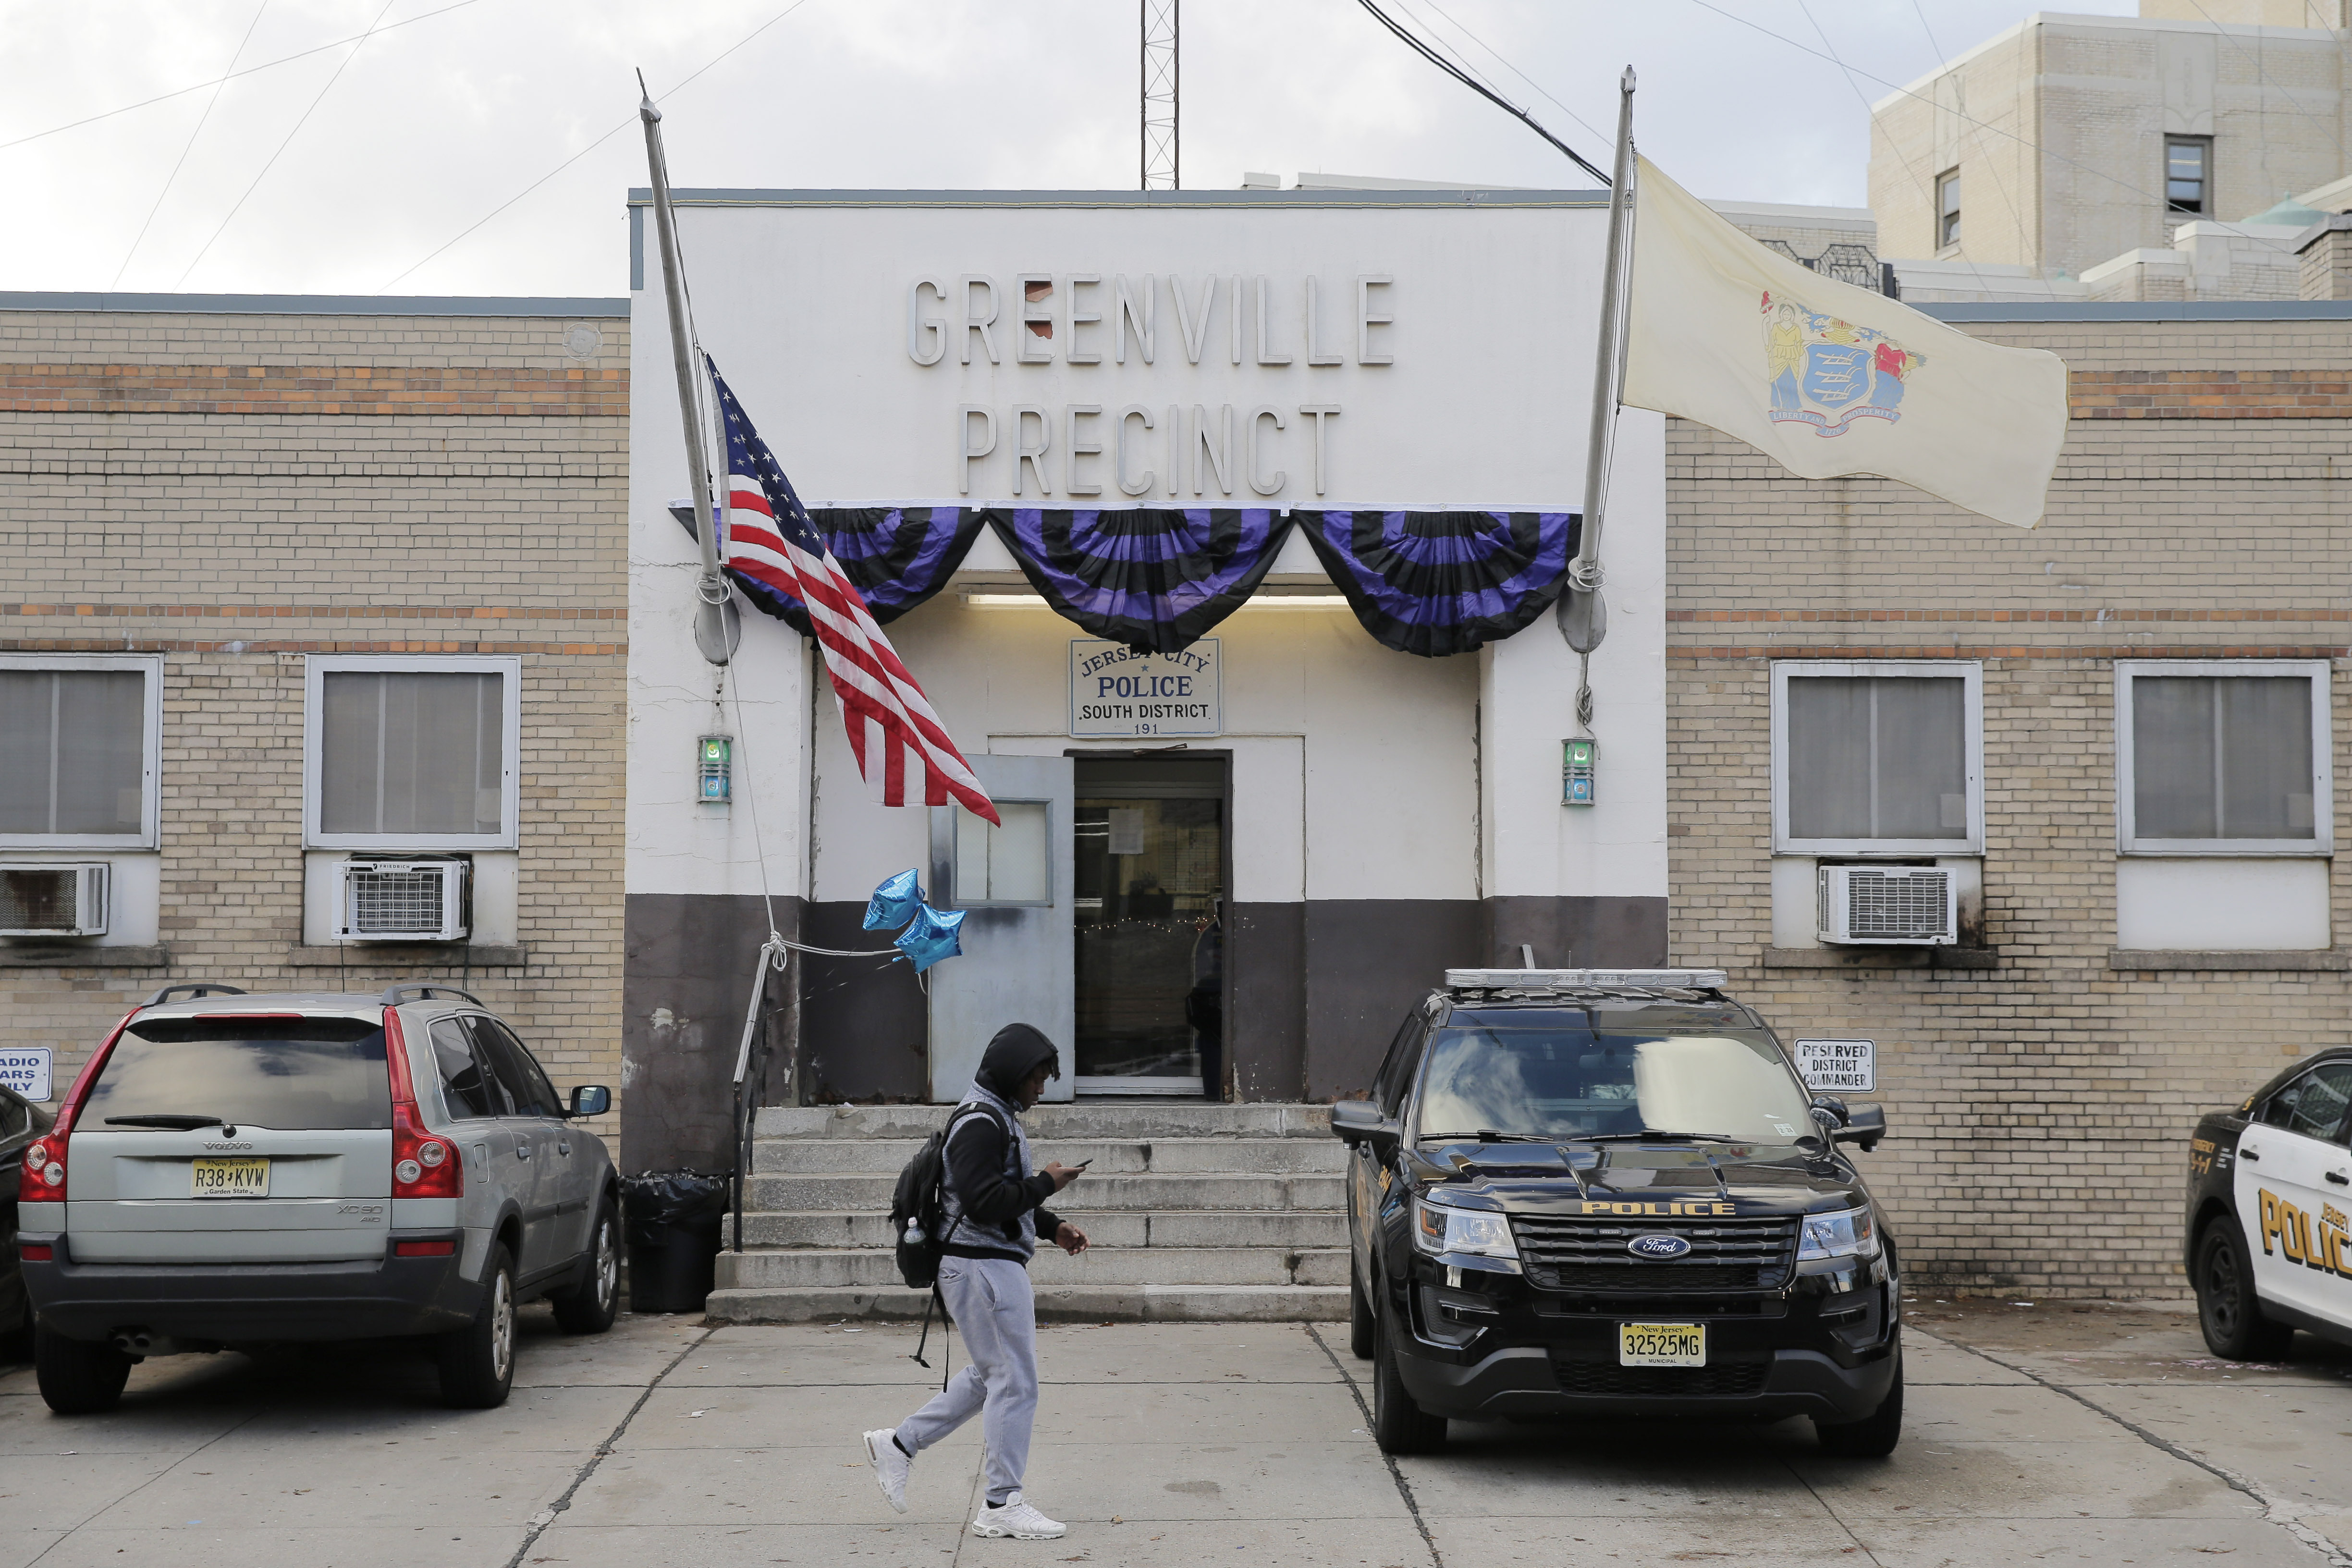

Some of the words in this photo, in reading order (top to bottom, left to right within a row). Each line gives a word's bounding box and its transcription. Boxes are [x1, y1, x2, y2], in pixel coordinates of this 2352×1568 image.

[907, 272, 1394, 367] GREENVILLE
[1773, 412, 1810, 420] LIBERTY
[1810, 416, 1825, 425] AND
[1843, 408, 1897, 421] PROSPERITY
[1825, 428, 1841, 436] 1776
[958, 403, 1341, 496] PRECINCT
[1082, 647, 1151, 677] JERS
[1098, 676, 1193, 698] POLICE
[1082, 705, 1132, 719] SOUTH
[1139, 704, 1209, 718] DISTRICT
[1134, 723, 1159, 735] 191
[1802, 1045, 1868, 1057] RESERVED
[0, 1058, 39, 1066] ADIO
[1813, 1059, 1858, 1072] DISTRICT
[0, 1070, 35, 1078] ARS
[1804, 1073, 1867, 1086] COMMANDER
[202, 1141, 253, 1150] VOLVO
[1581, 1201, 1736, 1215] POLICE
[2258, 1188, 2352, 1281] POLIC
[1643, 1237, 1676, 1253] Ford
[1660, 1325, 1684, 1334] Jersey
[1626, 1335, 1699, 1356] 32525MG
